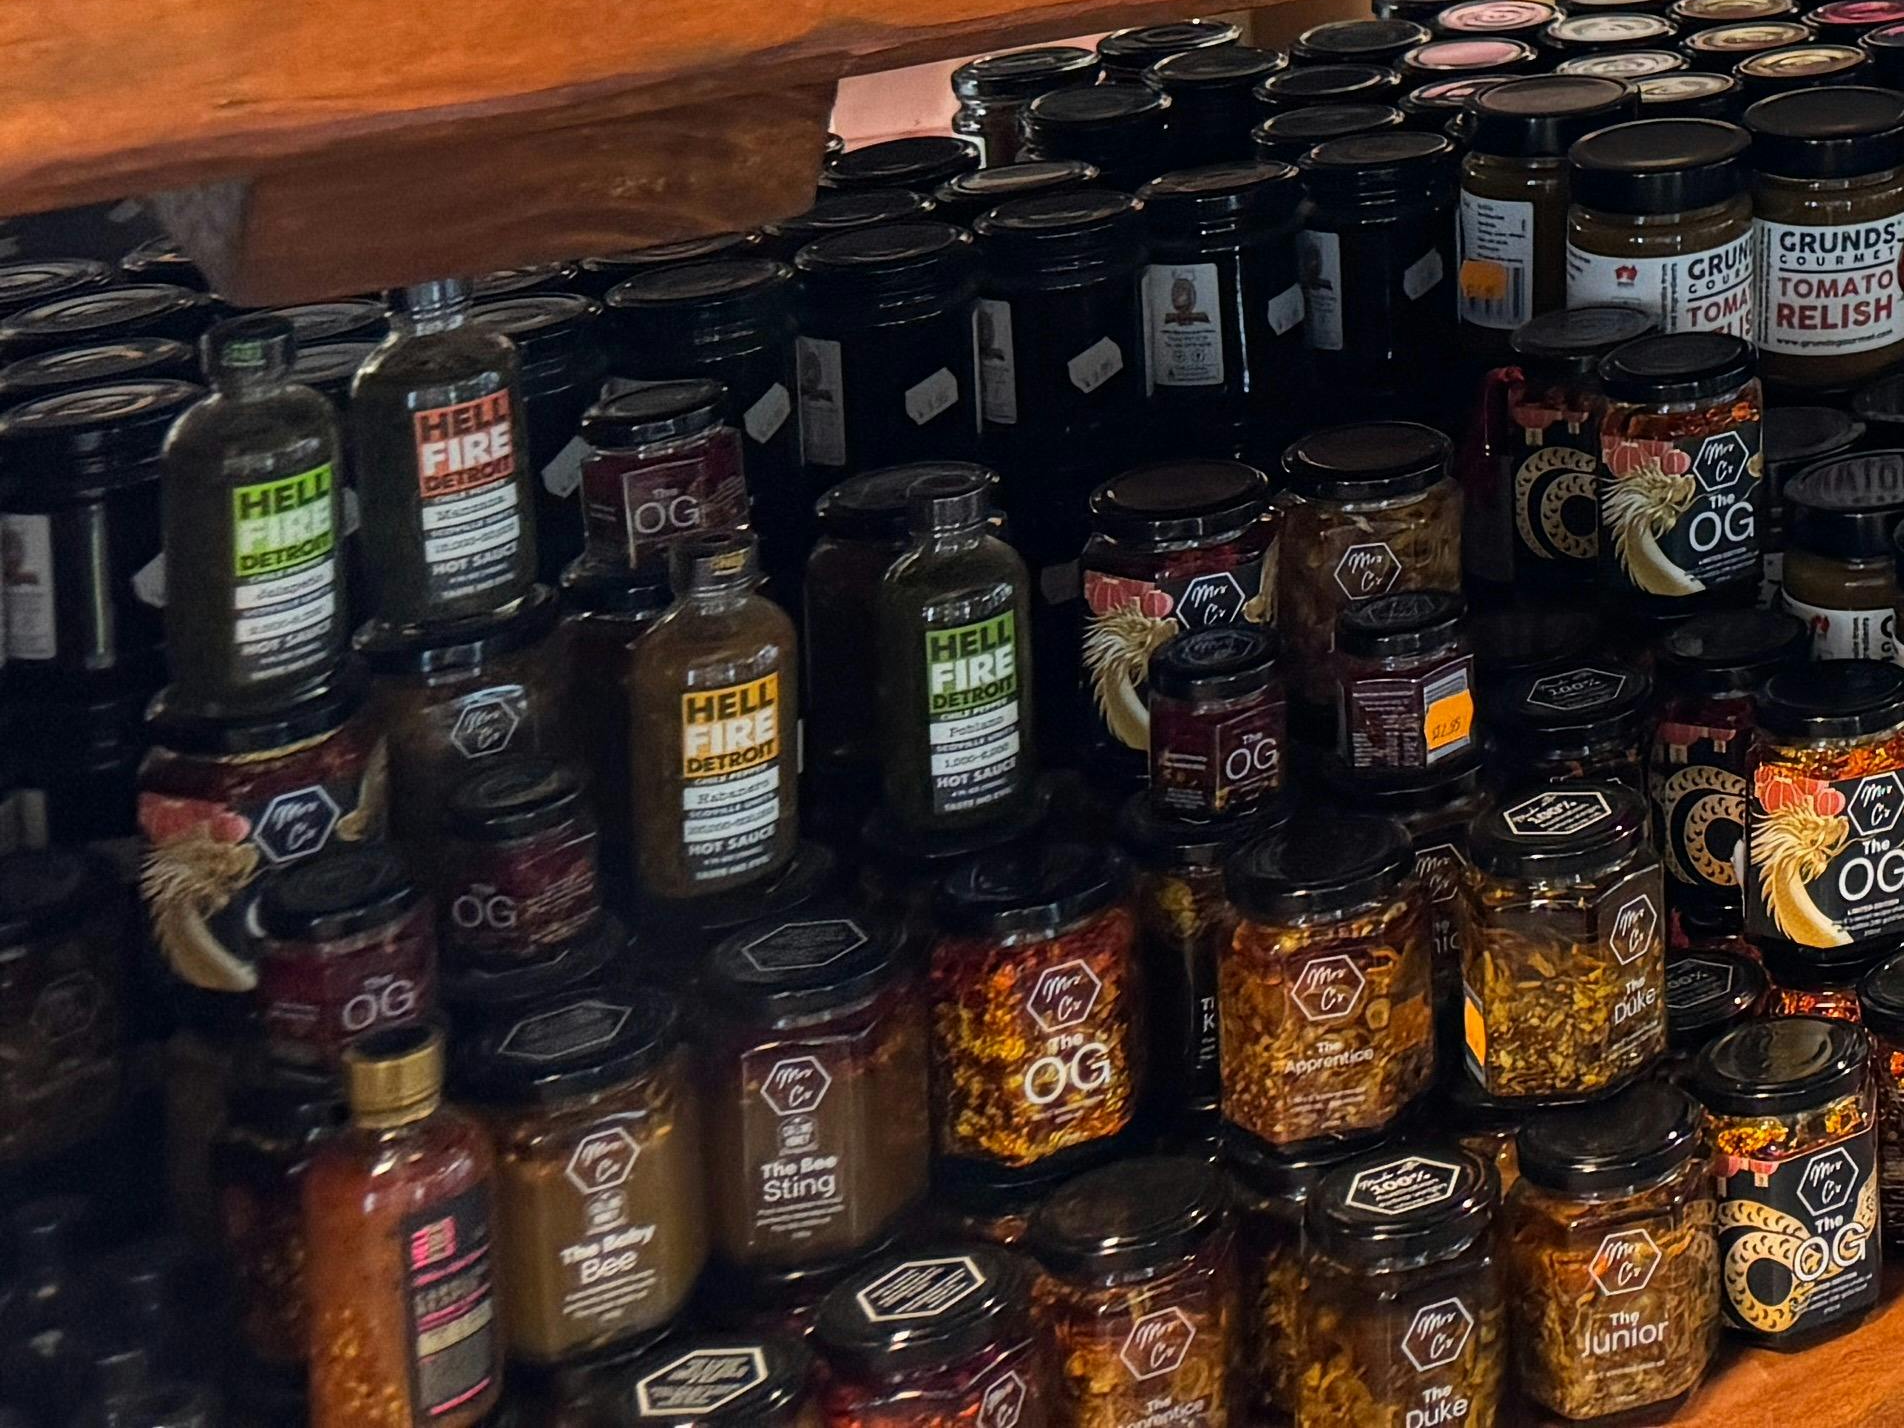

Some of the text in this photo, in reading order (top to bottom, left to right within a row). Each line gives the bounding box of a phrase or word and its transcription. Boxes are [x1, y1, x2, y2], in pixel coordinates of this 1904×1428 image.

[1778, 245, 1896, 267] GOURMET
[1776, 270, 1894, 300] TOMATO
[1776, 296, 1894, 331] RELISH
[421, 397, 510, 440] HELL
[422, 420, 511, 478] FIRE
[238, 468, 332, 521] HELL
[1709, 492, 1735, 509] The
[237, 497, 333, 553] FIRE
[633, 494, 700, 535] OG
[1689, 501, 1756, 554] OG
[929, 620, 1013, 663] HELL
[931, 645, 1015, 695] FIRE
[687, 681, 774, 724] HELL
[932, 676, 1014, 711] DETROIT
[687, 707, 775, 757] FIRE
[687, 741, 775, 775] DETROIT
[936, 756, 1017, 789] HOT SAUCE
[1225, 739, 1278, 782] OG
[688, 823, 776, 857] HOT SAUCE
[1862, 839, 1890, 855] The
[453, 892, 518, 931] OG
[1624, 975, 1645, 996] The
[342, 979, 417, 1032] OG
[1613, 988, 1657, 1027] Duke
[1284, 1045, 1375, 1076] Apprentice
[1318, 1041, 1342, 1056] The
[1025, 1042, 1110, 1105] OG
[761, 1153, 839, 1180] The Bee
[763, 1170, 837, 1203] Sting
[1814, 1216, 1844, 1235] The
[560, 1243, 599, 1264] The
[580, 1250, 638, 1285] Bee
[1793, 1222, 1867, 1283] OG
[1609, 1311, 1640, 1327] The
[1582, 1319, 1669, 1358] Junior
[1422, 1385, 1454, 1403] The
[1405, 1397, 1469, 1428] Duke
